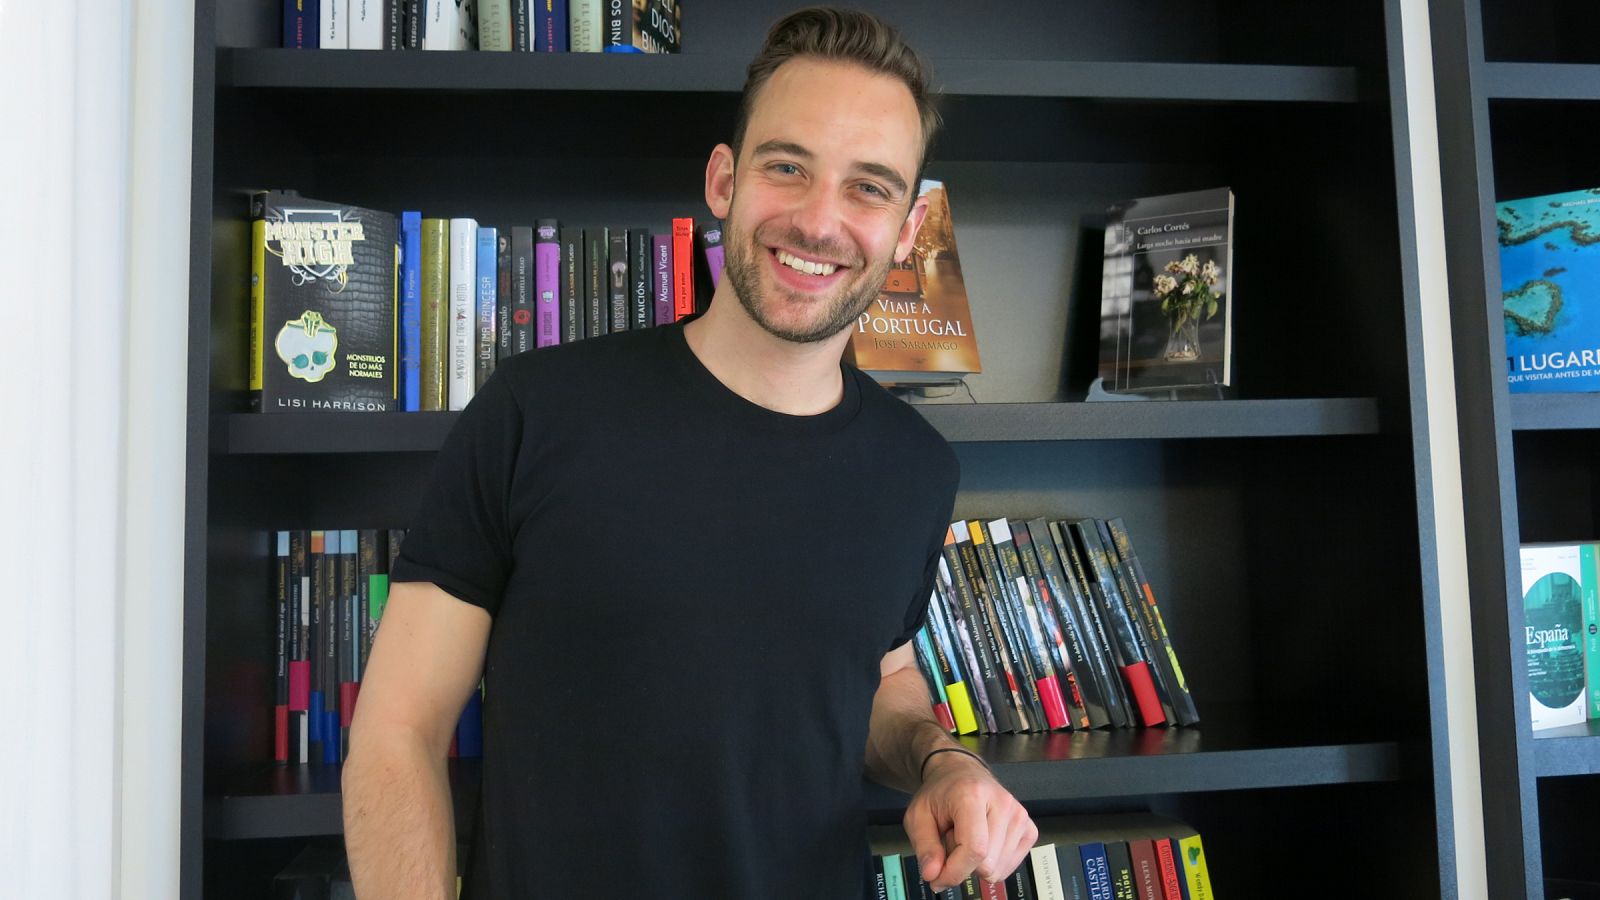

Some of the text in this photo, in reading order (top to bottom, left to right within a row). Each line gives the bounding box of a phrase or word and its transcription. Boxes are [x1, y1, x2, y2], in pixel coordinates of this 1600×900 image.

[651, 8, 674, 44] DIOS
[265, 221, 365, 241] MONSTER
[1137, 222, 1190, 236] Carlos Cortés
[1155, 239, 1173, 248] noche
[1174, 237, 1190, 246] hacia
[1202, 234, 1223, 243] madre
[282, 240, 354, 266] HIGH
[659, 245, 669, 270] Vicent
[518, 256, 527, 275] MEAD
[518, 275, 527, 304] RICHELLE
[659, 271, 669, 303] Manuel
[481, 275, 492, 323] PRINCESA
[636, 281, 646, 324] TRAICIÓN
[877, 299, 932, 316] VIAJE A
[612, 293, 625, 329] OBSESIÓN
[499, 305, 512, 347] crepúsculo
[857, 312, 967, 337] PORTUGAL
[479, 327, 492, 360] ÚLTIMA
[901, 338, 958, 351] SARAMAGO
[346, 354, 386, 365] MONSTRUOS
[349, 362, 383, 372] DE LO MÁS
[349, 370, 383, 380] NORMALES
[1507, 369, 1592, 384] QUE VISITAR ANTES DE
[278, 398, 386, 413] LISI HARRISON
[954, 569, 965, 588] Rivera
[959, 586, 971, 608] Hernán
[1066, 623, 1073, 631] de
[1068, 629, 1076, 641] vida
[1148, 625, 1160, 641] Gilles
[1525, 624, 1569, 648] España
[1071, 640, 1080, 655] doble
[1103, 643, 1110, 651] La
[977, 647, 989, 670] nombre
[1075, 654, 1083, 662] La
[983, 668, 992, 679] Mi
[1085, 858, 1103, 900] CASTLE
[1095, 856, 1110, 900] RICHARD
[1141, 859, 1152, 884] ELENA
[1013, 871, 1024, 897] Centeno
[1193, 872, 1203, 894] Wendy
